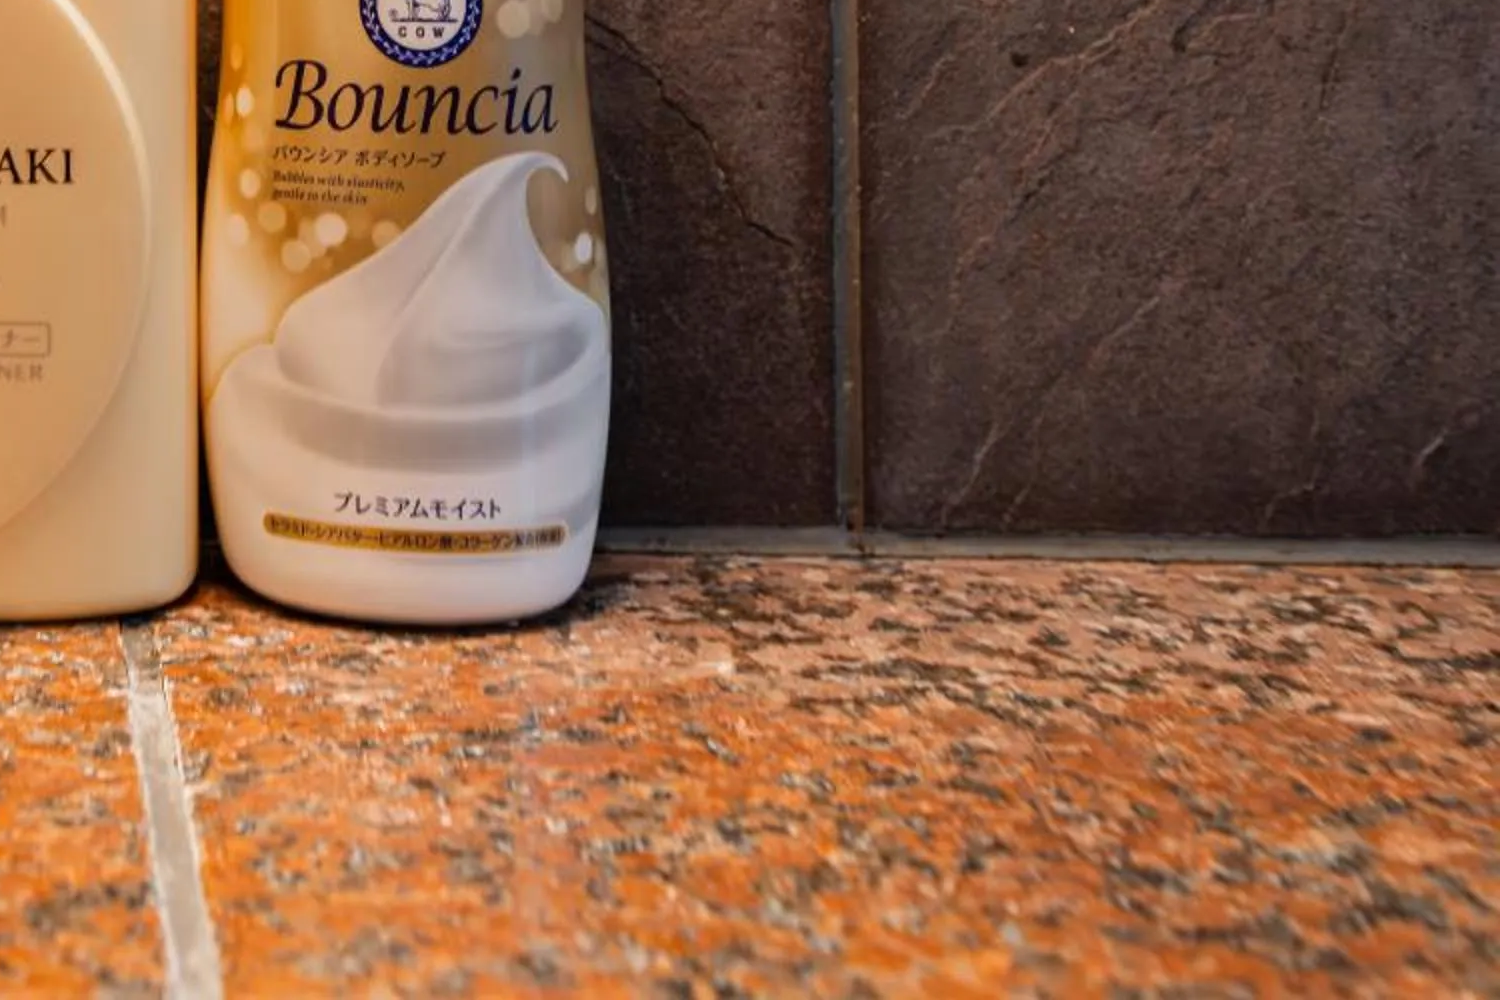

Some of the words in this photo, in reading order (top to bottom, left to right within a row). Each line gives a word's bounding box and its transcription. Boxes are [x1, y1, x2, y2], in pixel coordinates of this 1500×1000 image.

[398, 26, 445, 38] COW
[275, 59, 559, 136] Bouncia
[271, 143, 349, 164] バウンシア
[355, 148, 448, 168] ボディソープ
[334, 491, 502, 520] プレミアムモイスト
